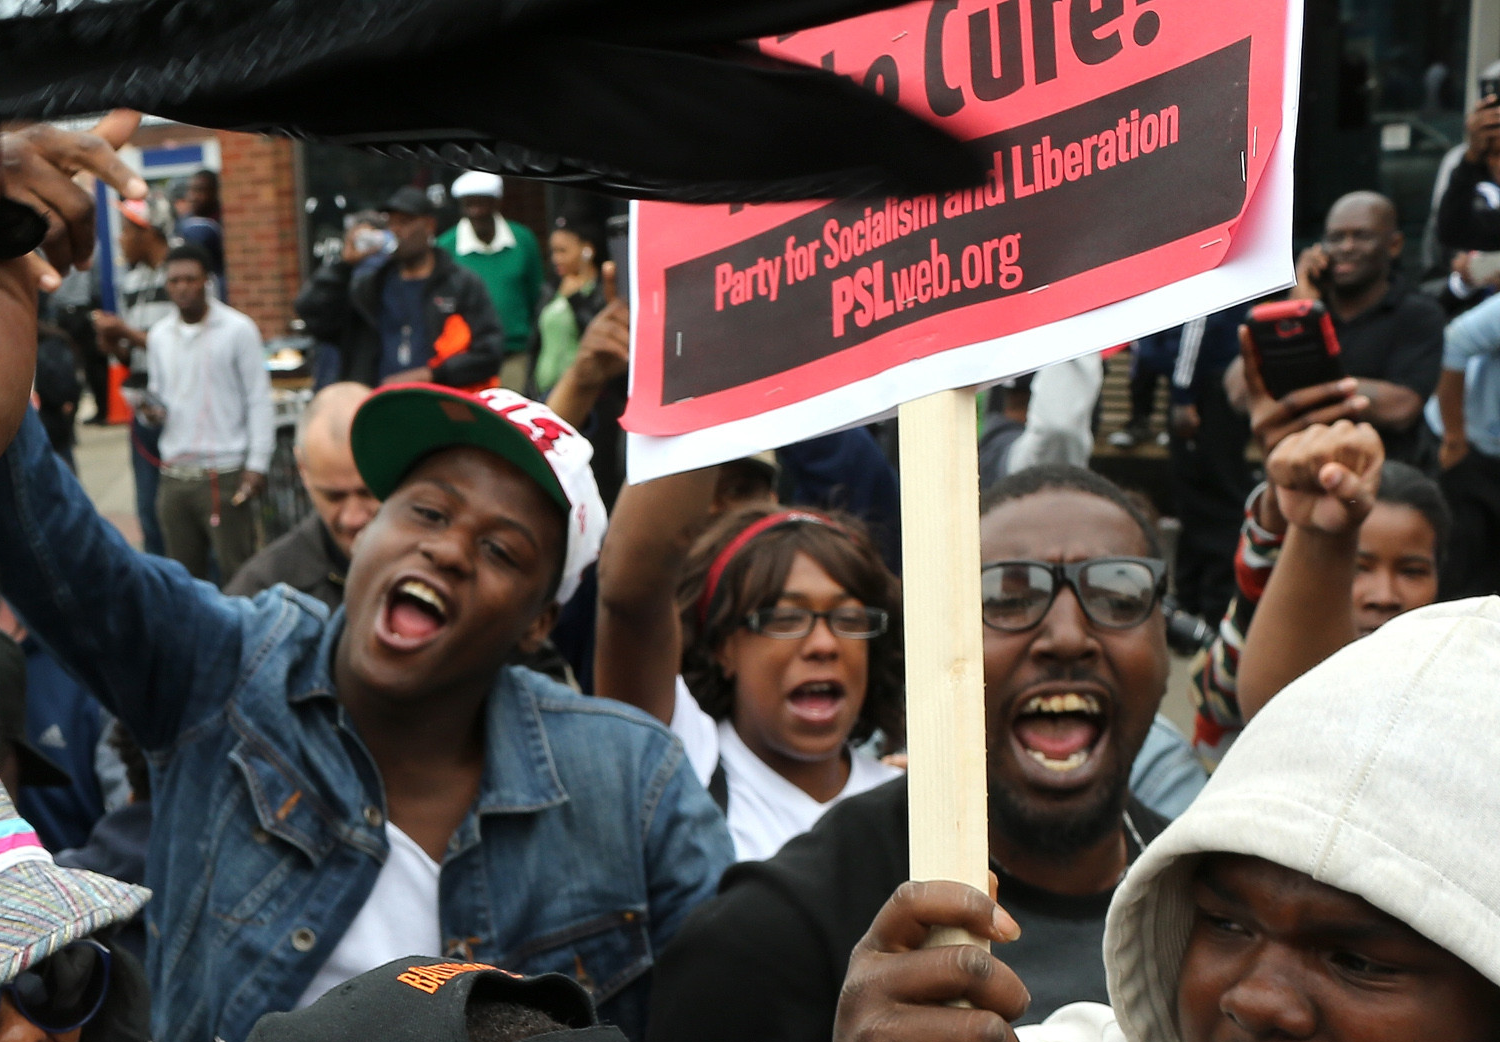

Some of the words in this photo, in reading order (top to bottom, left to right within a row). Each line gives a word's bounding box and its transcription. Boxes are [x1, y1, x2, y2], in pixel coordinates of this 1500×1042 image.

[715, 255, 782, 312] Party
[785, 235, 820, 285] for
[823, 193, 938, 269] Socialism
[943, 150, 1006, 219] and
[1011, 104, 1179, 199] Liberation
[831, 232, 1023, 338] PSLweb.org
